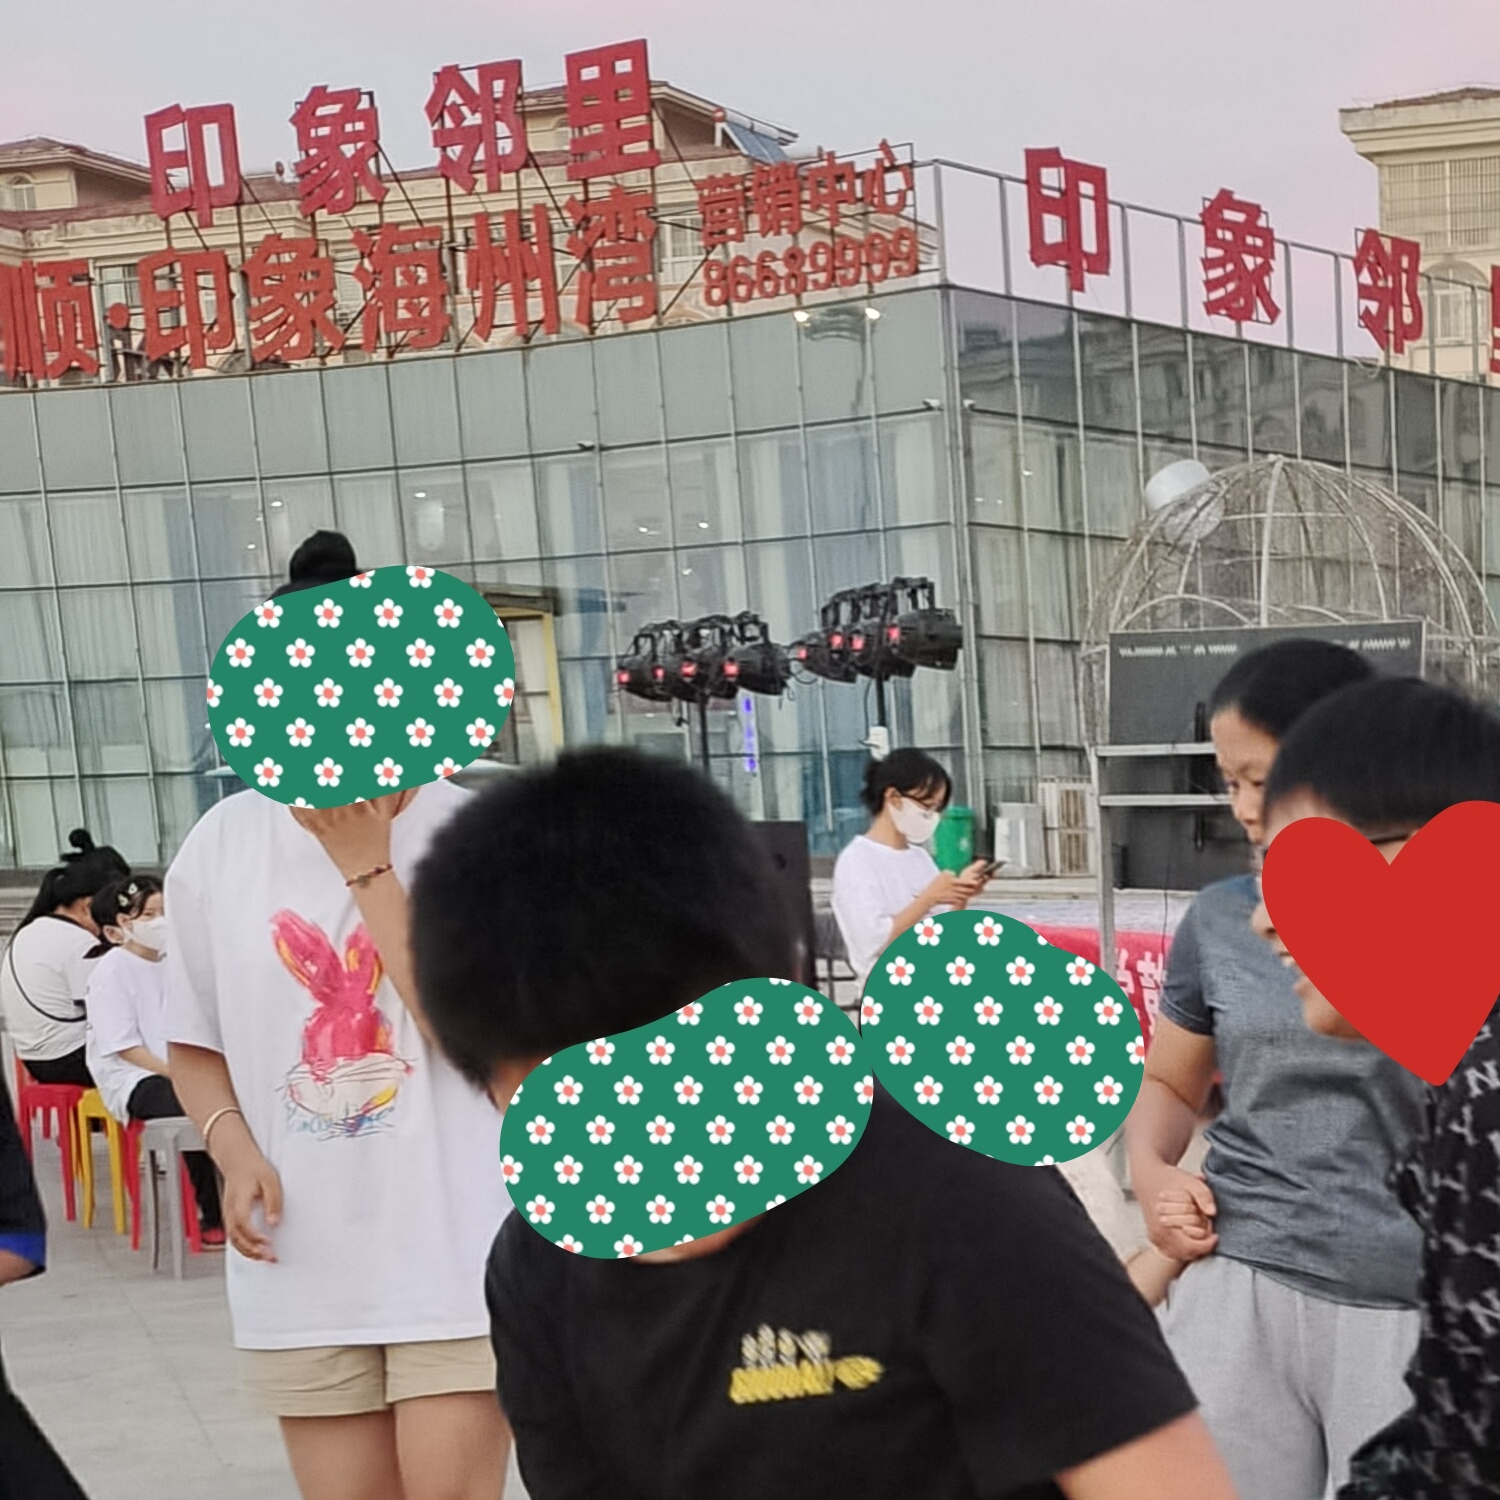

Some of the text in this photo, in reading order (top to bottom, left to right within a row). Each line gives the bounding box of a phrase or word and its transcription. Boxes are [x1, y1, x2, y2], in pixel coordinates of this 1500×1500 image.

[144, 38, 660, 228] 印象邻里
[696, 138, 914, 247] 营销中心
